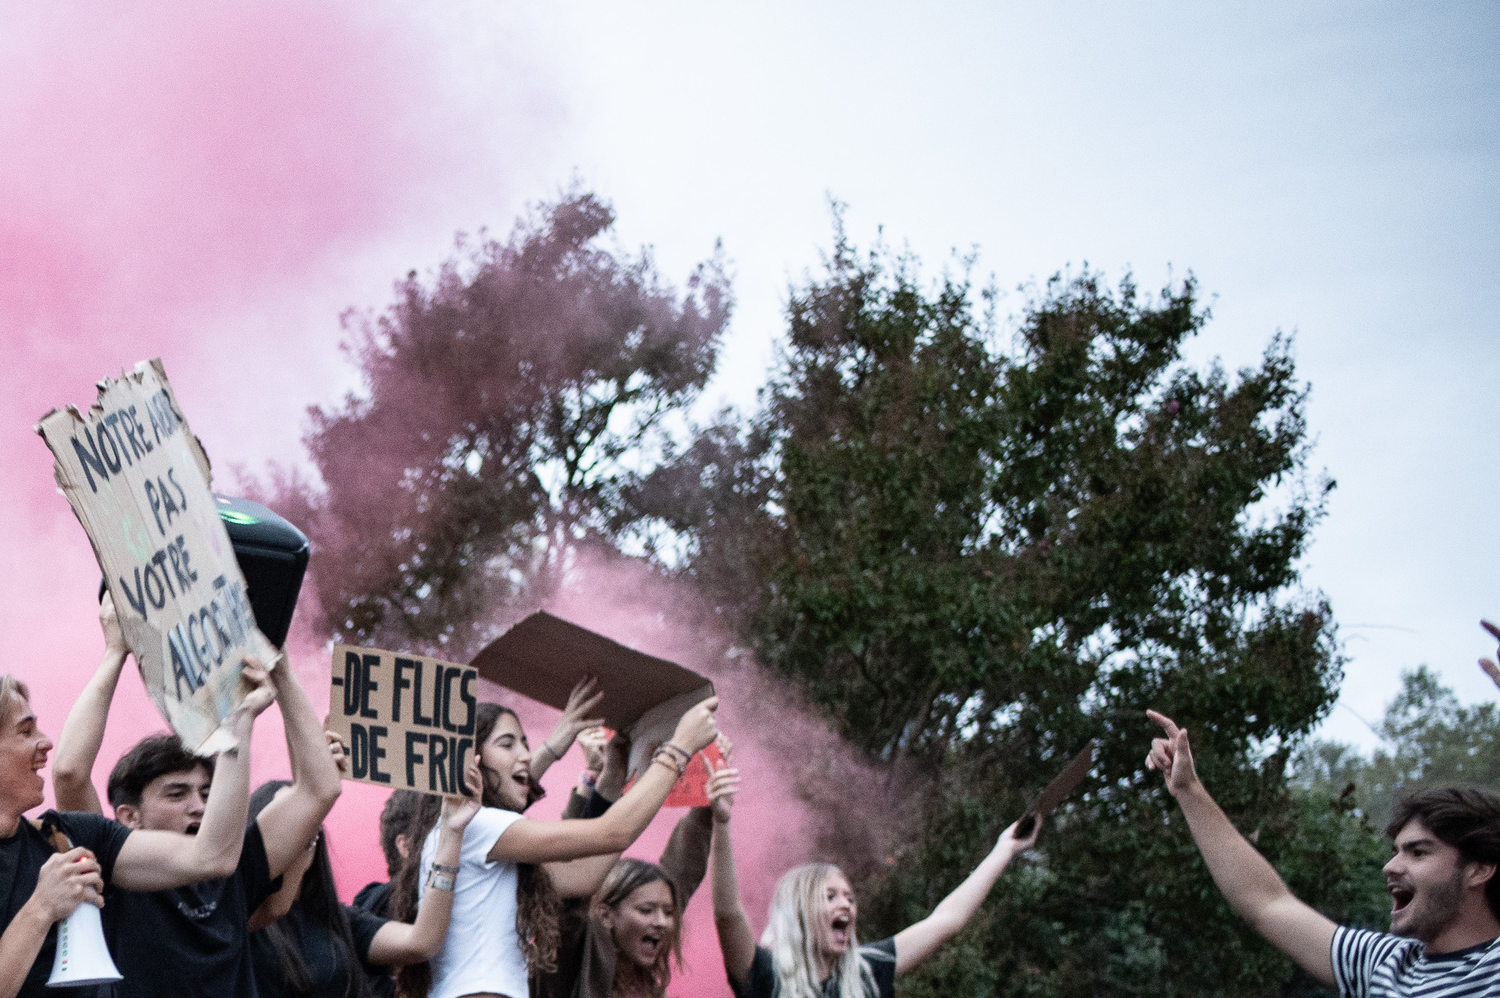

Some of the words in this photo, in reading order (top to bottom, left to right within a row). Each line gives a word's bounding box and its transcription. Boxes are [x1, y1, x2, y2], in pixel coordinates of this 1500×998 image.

[71, 404, 154, 494] NOTRE
[144, 467, 187, 536] PAS
[119, 535, 199, 618] VOTRE
[391, 657, 478, 736] FLICS
[405, 731, 474, 798] FRIC
